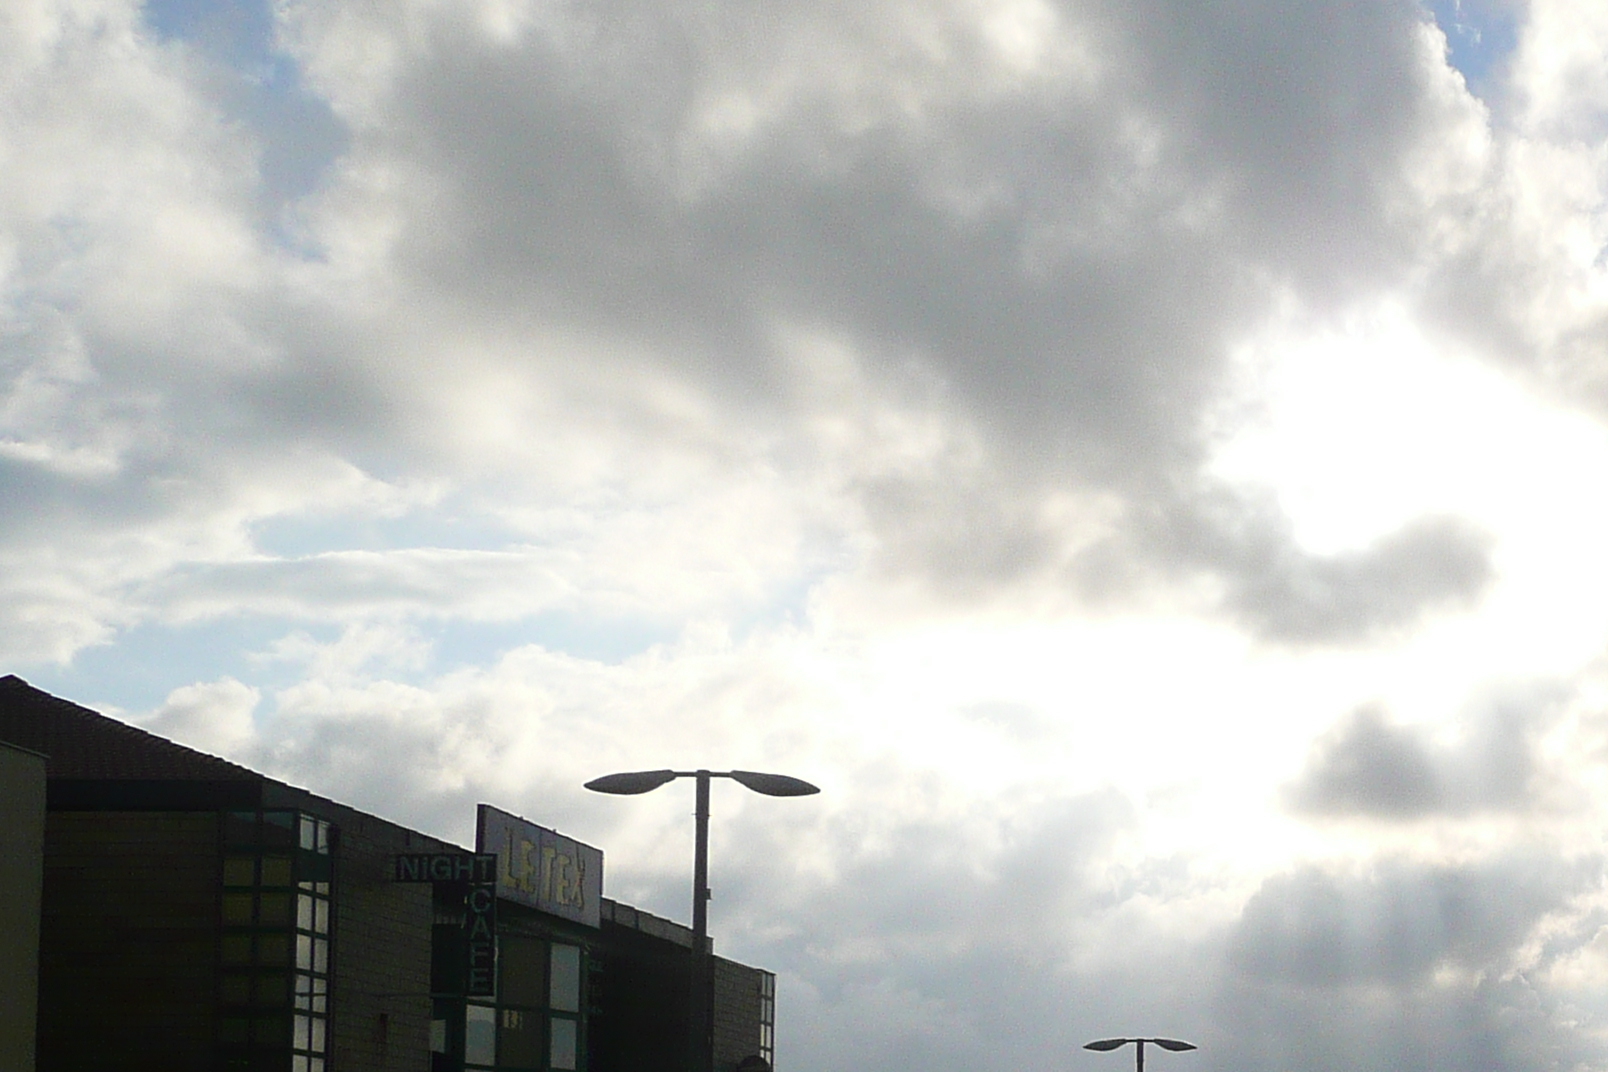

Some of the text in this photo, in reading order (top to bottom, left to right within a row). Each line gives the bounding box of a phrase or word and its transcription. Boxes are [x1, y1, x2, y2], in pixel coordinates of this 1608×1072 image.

[399, 856, 494, 881] NIGHT
[503, 827, 587, 910] LE TEX
[470, 888, 493, 994] CAFE
